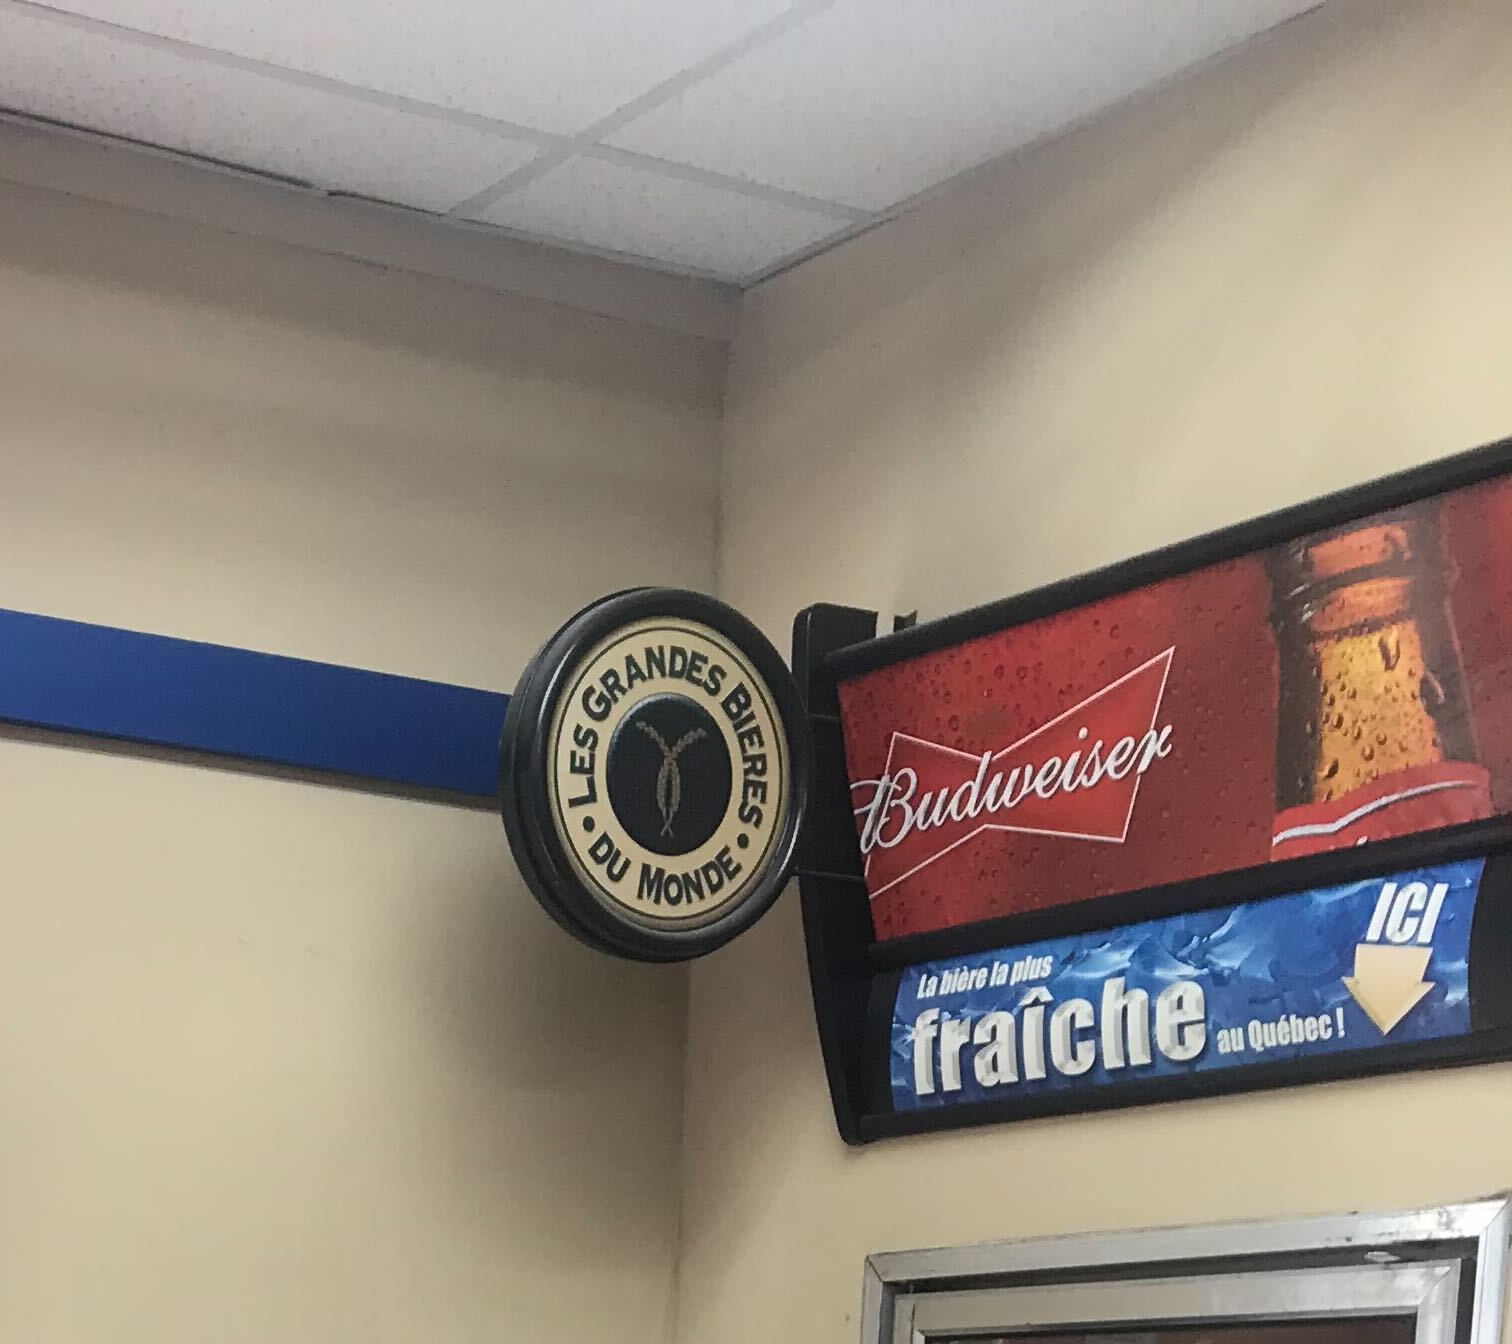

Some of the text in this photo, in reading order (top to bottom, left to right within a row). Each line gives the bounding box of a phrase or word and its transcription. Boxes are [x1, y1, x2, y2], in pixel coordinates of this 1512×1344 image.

[568, 645, 768, 830] LES GRANDES BIERES
[849, 724, 1173, 854] Budweiser
[588, 831, 743, 906] DU MONDE
[1365, 880, 1449, 945] ICI
[917, 953, 1053, 1000] La bière la plus
[912, 976, 1207, 1096] fraîche
[1217, 1026, 1245, 1055] au
[1247, 1012, 1335, 1050] Québec
